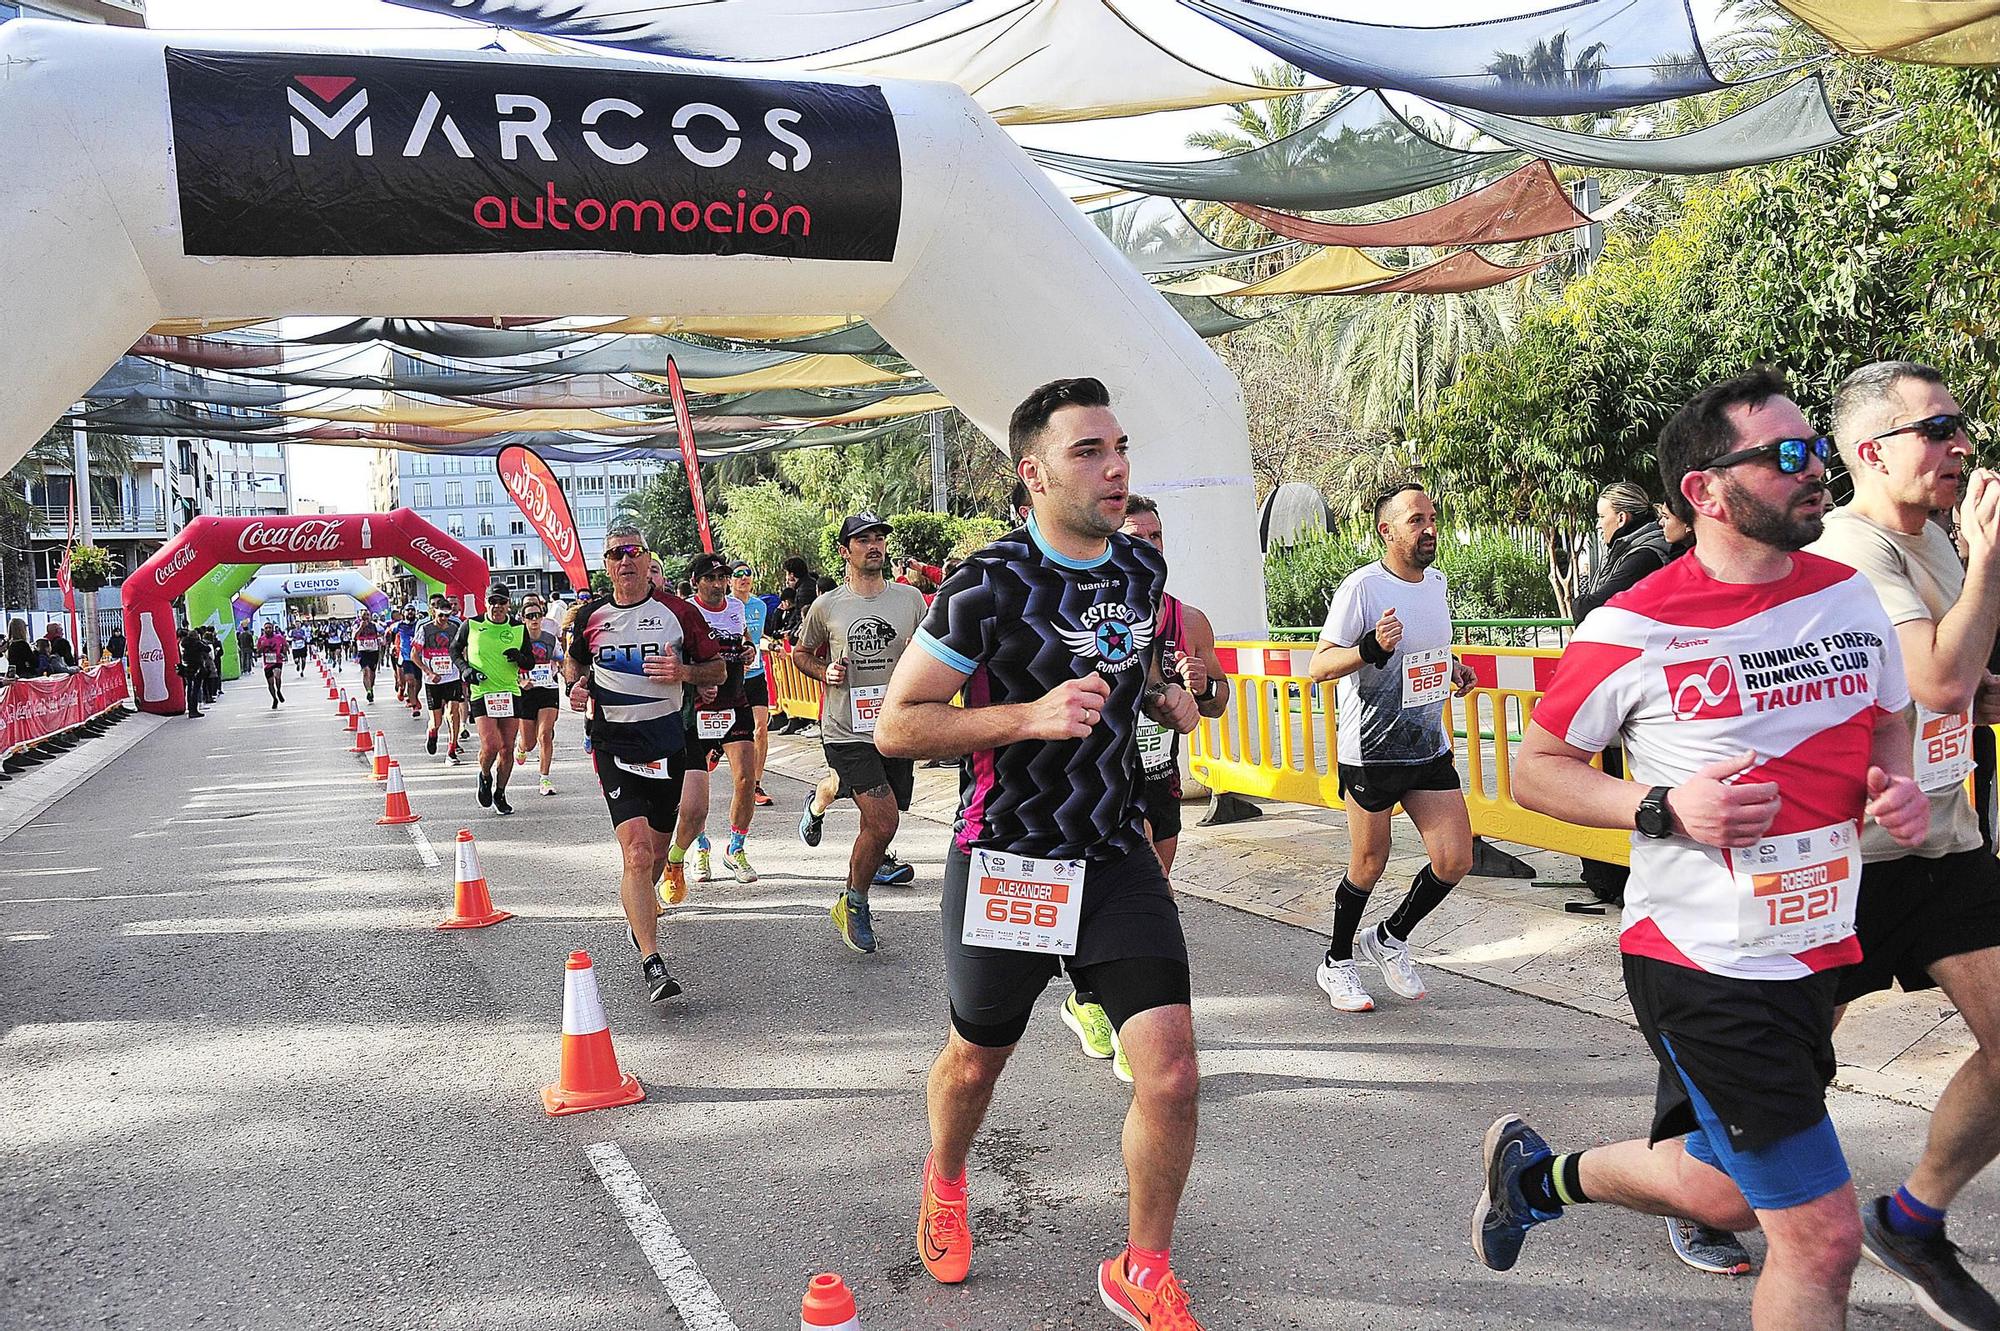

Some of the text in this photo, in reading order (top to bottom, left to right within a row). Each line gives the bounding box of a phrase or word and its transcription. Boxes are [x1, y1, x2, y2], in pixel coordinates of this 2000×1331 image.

[286, 85, 813, 172] MARCOS
[474, 181, 811, 236] automoción
[238, 519, 346, 553] Coca-Cola
[155, 543, 198, 585] Coca-Cola
[410, 536, 460, 570] Coca-Cola
[294, 578, 340, 588] EVENTOS
[1077, 580, 1110, 591] luanvi
[1079, 602, 1137, 630] ESTESO
[848, 639, 885, 652] TRAIL
[1673, 637, 1710, 650] Scimitar
[1739, 642, 1820, 670] RUNNING
[1095, 653, 1139, 674] RUNNERS
[1744, 651, 1869, 690] RUNNING CLUB
[1412, 674, 1443, 692] 869
[1750, 673, 1869, 712] TAUNTON
[704, 720, 729, 729] 505
[1928, 728, 1968, 764] 857
[996, 881, 1053, 900] ALEXANDER
[1780, 865, 1828, 892] ROBERTO
[985, 898, 1058, 928] 658
[1766, 886, 1838, 926] 1221
